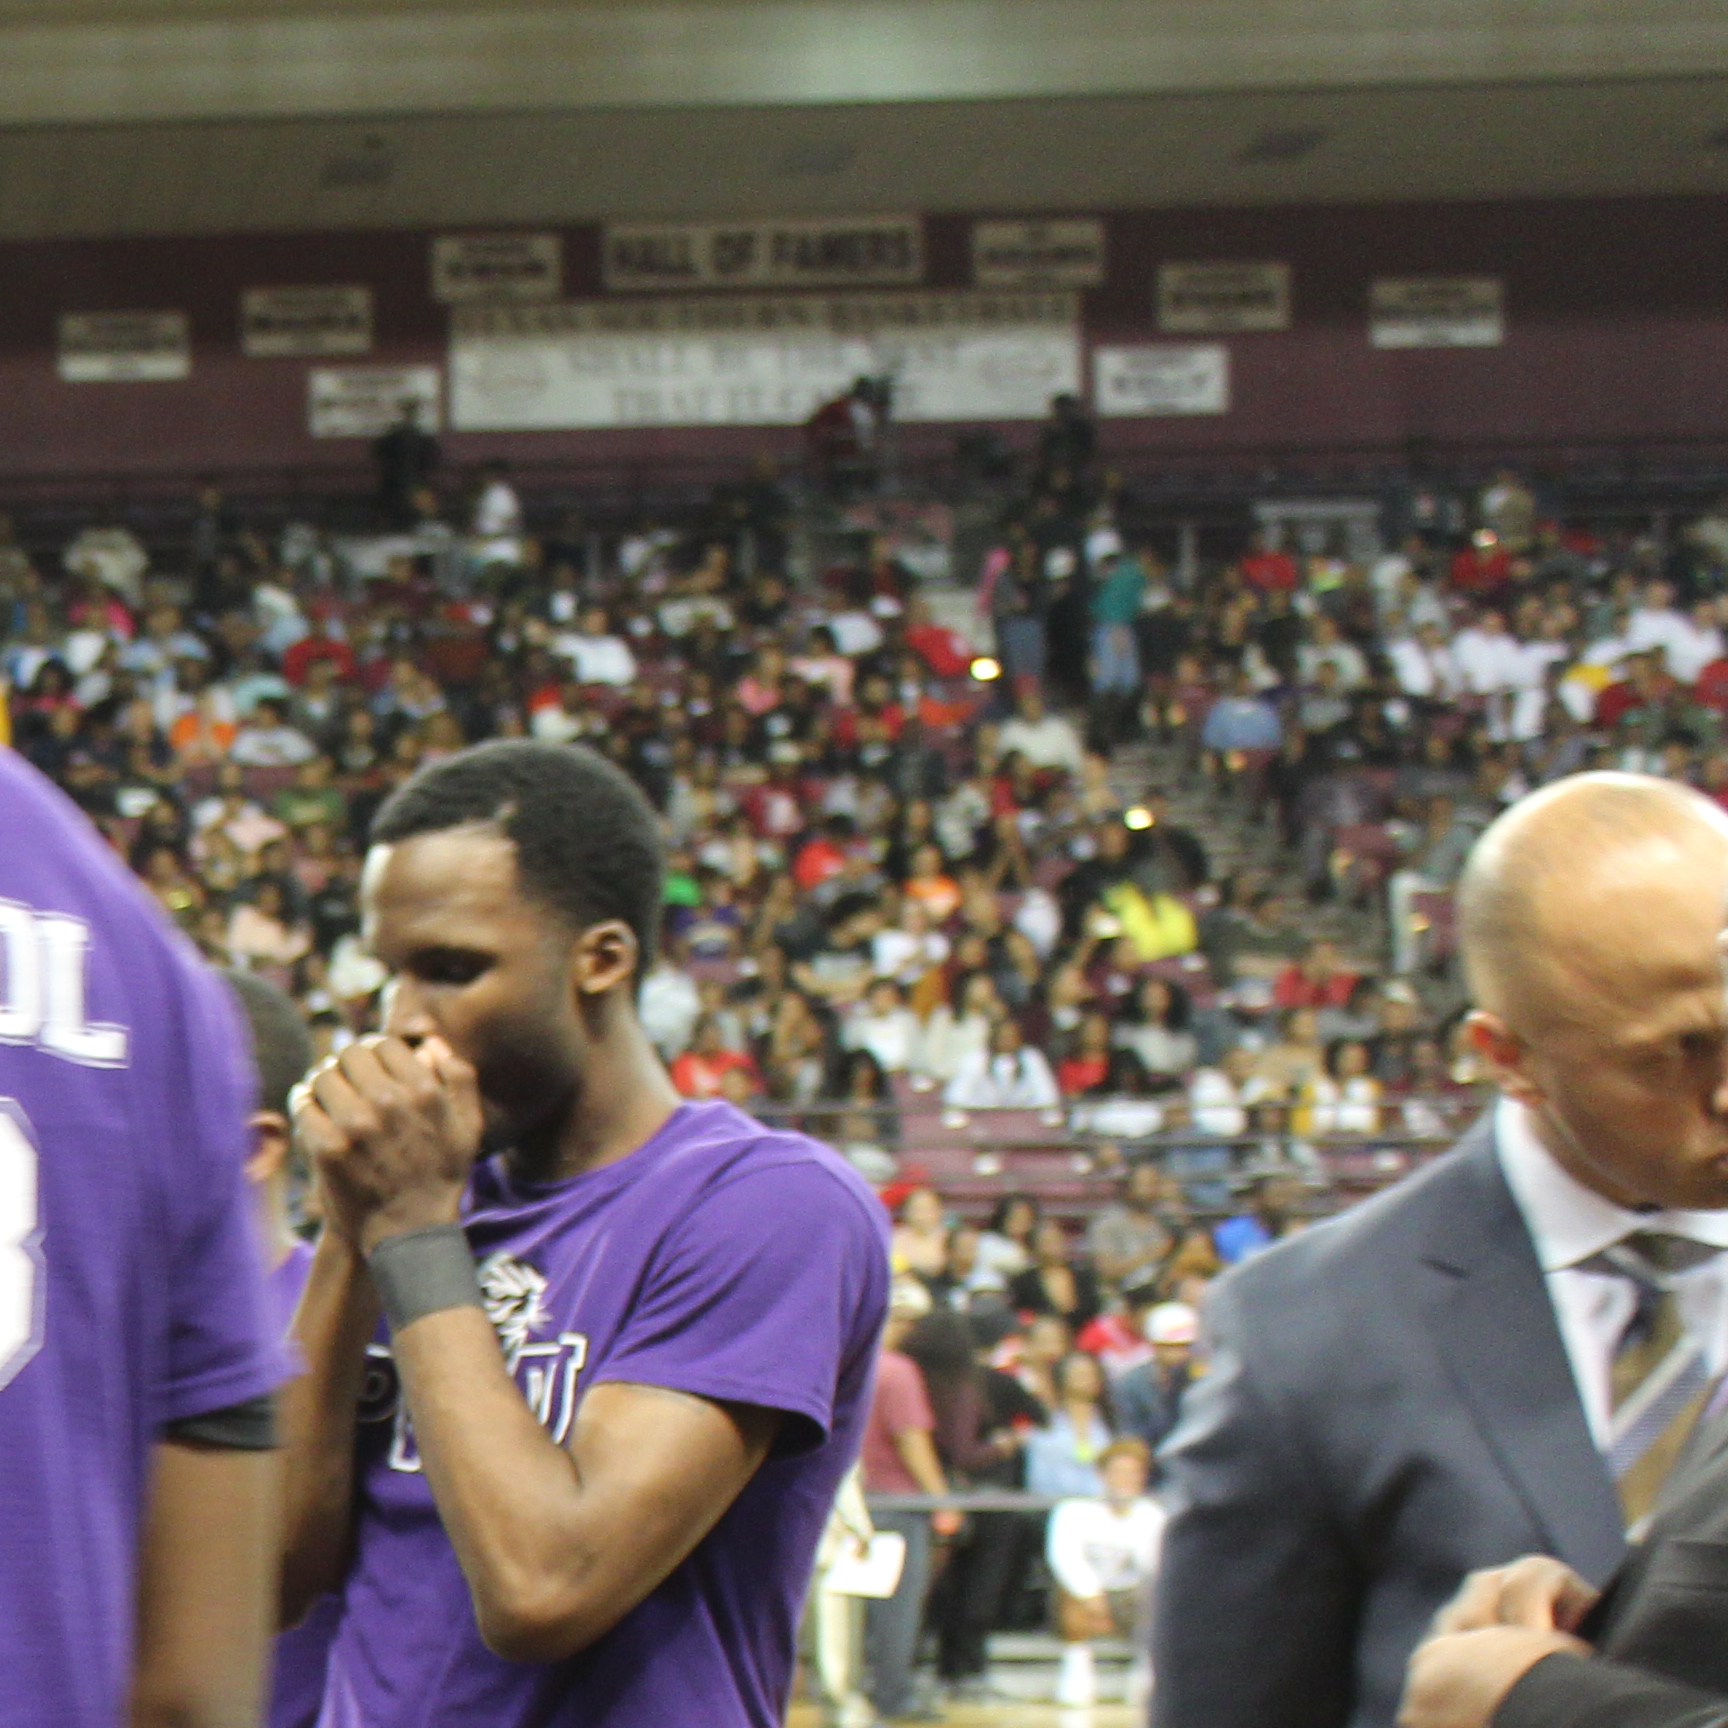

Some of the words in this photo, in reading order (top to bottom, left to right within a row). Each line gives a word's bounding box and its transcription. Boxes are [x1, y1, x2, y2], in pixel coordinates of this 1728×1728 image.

[612, 236, 697, 276] HALL
[711, 230, 757, 274] OF
[771, 226, 911, 272] FAMERS
